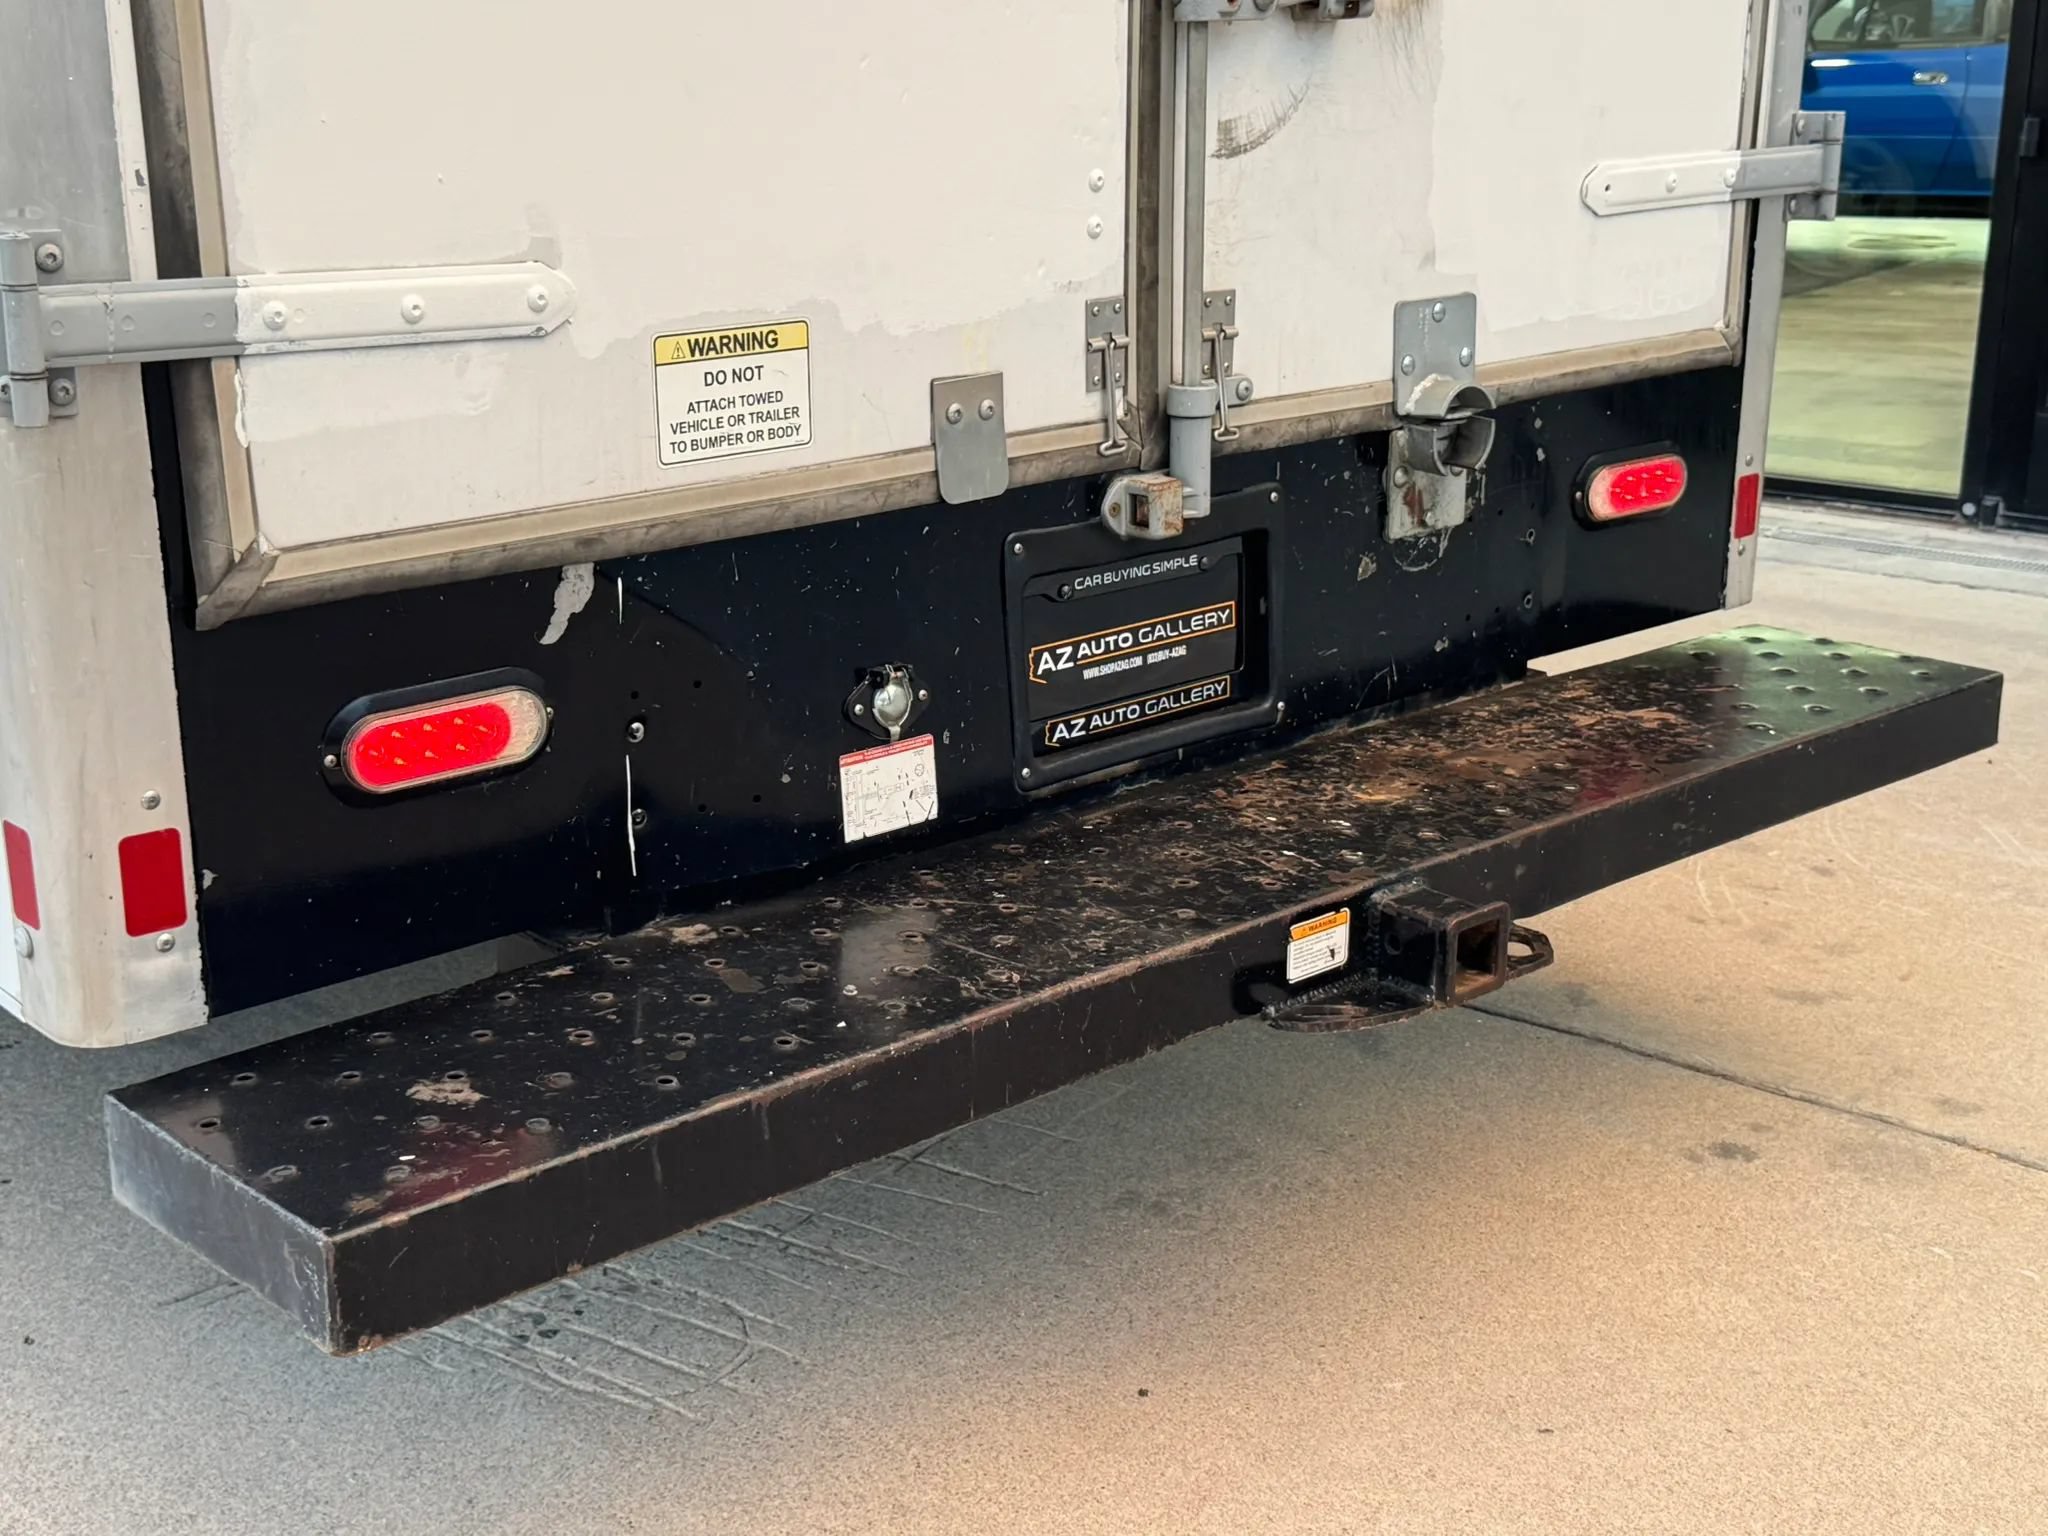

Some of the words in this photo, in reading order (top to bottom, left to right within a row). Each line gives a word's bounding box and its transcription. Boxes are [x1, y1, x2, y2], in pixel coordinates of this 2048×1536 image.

[687, 330, 779, 358] WARNING
[704, 370, 727, 387] DO
[732, 365, 764, 383] NOT
[687, 397, 735, 415] ATTACH
[738, 390, 784, 407] TOWED
[670, 416, 724, 435] VEHICLE
[727, 413, 746, 427] OR
[748, 406, 800, 424] TRAILER
[669, 440, 687, 454] TO
[691, 432, 744, 451] BUMPER
[746, 430, 765, 443] OR
[768, 423, 802, 440] BODY
[1074, 573, 1102, 590] CAR
[1103, 564, 1152, 585] BUYING
[1152, 554, 1198, 574] SIMPLE
[1036, 645, 1075, 676] AZ
[1077, 632, 1133, 659] AUTO
[1138, 608, 1231, 643] GALLERY
[1052, 717, 1087, 743] AZ
[1089, 704, 1140, 730] AUTO
[1145, 681, 1227, 715] GALLERY
[1307, 917, 1337, 931] WARNING
